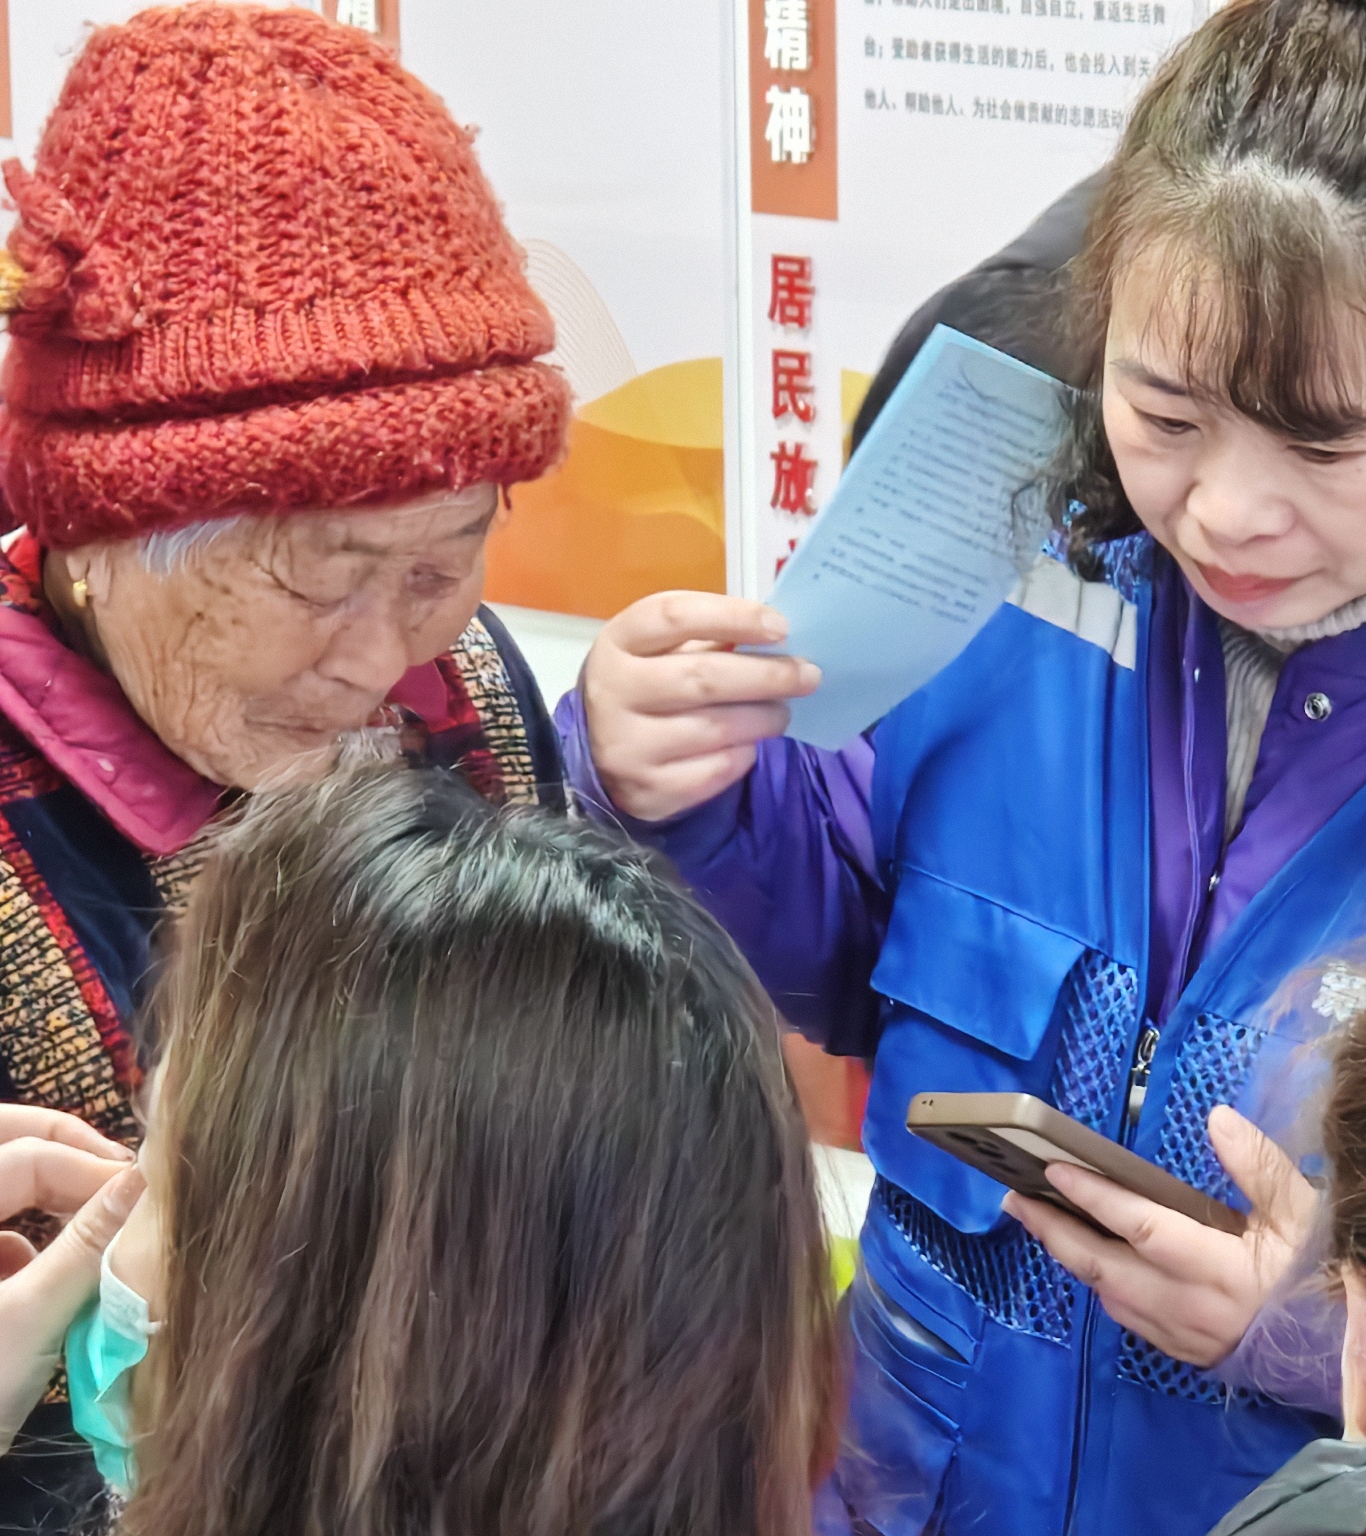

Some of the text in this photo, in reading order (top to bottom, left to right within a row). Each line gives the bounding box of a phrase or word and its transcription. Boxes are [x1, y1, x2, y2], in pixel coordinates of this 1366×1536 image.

[764, 0, 811, 164] 精神
[767, 253, 818, 580] 居民放
